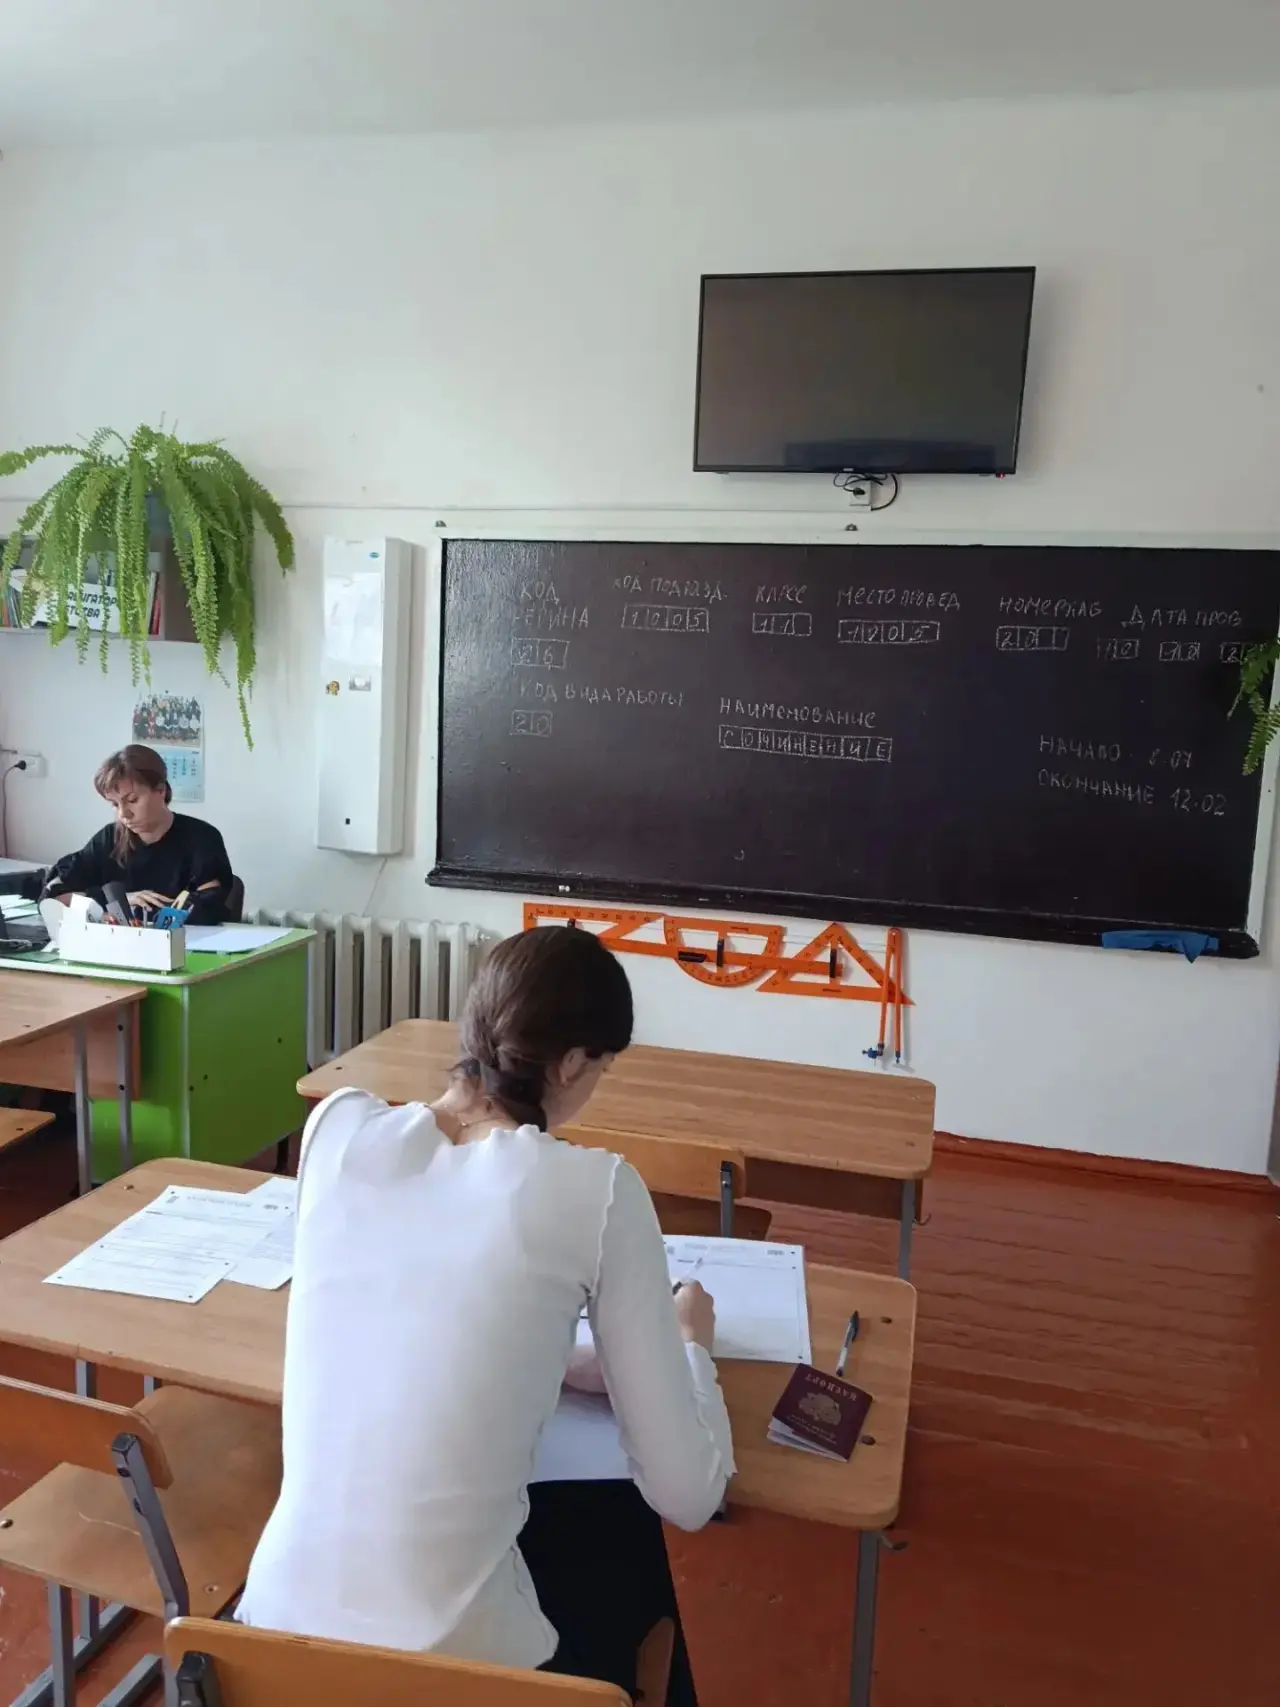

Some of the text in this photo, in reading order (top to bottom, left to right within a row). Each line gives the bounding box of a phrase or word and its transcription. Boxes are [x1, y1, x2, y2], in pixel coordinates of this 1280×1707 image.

[837, 586, 896, 607] МЕСТО
[617, 686, 684, 707] РАБОТЫ
[719, 697, 877, 728] НАИМЕНОВАНИЕ
[723, 730, 889, 759] СОЧИНЕНИЕ
[1038, 768, 1155, 805] ОКОНЧАНИЕ
